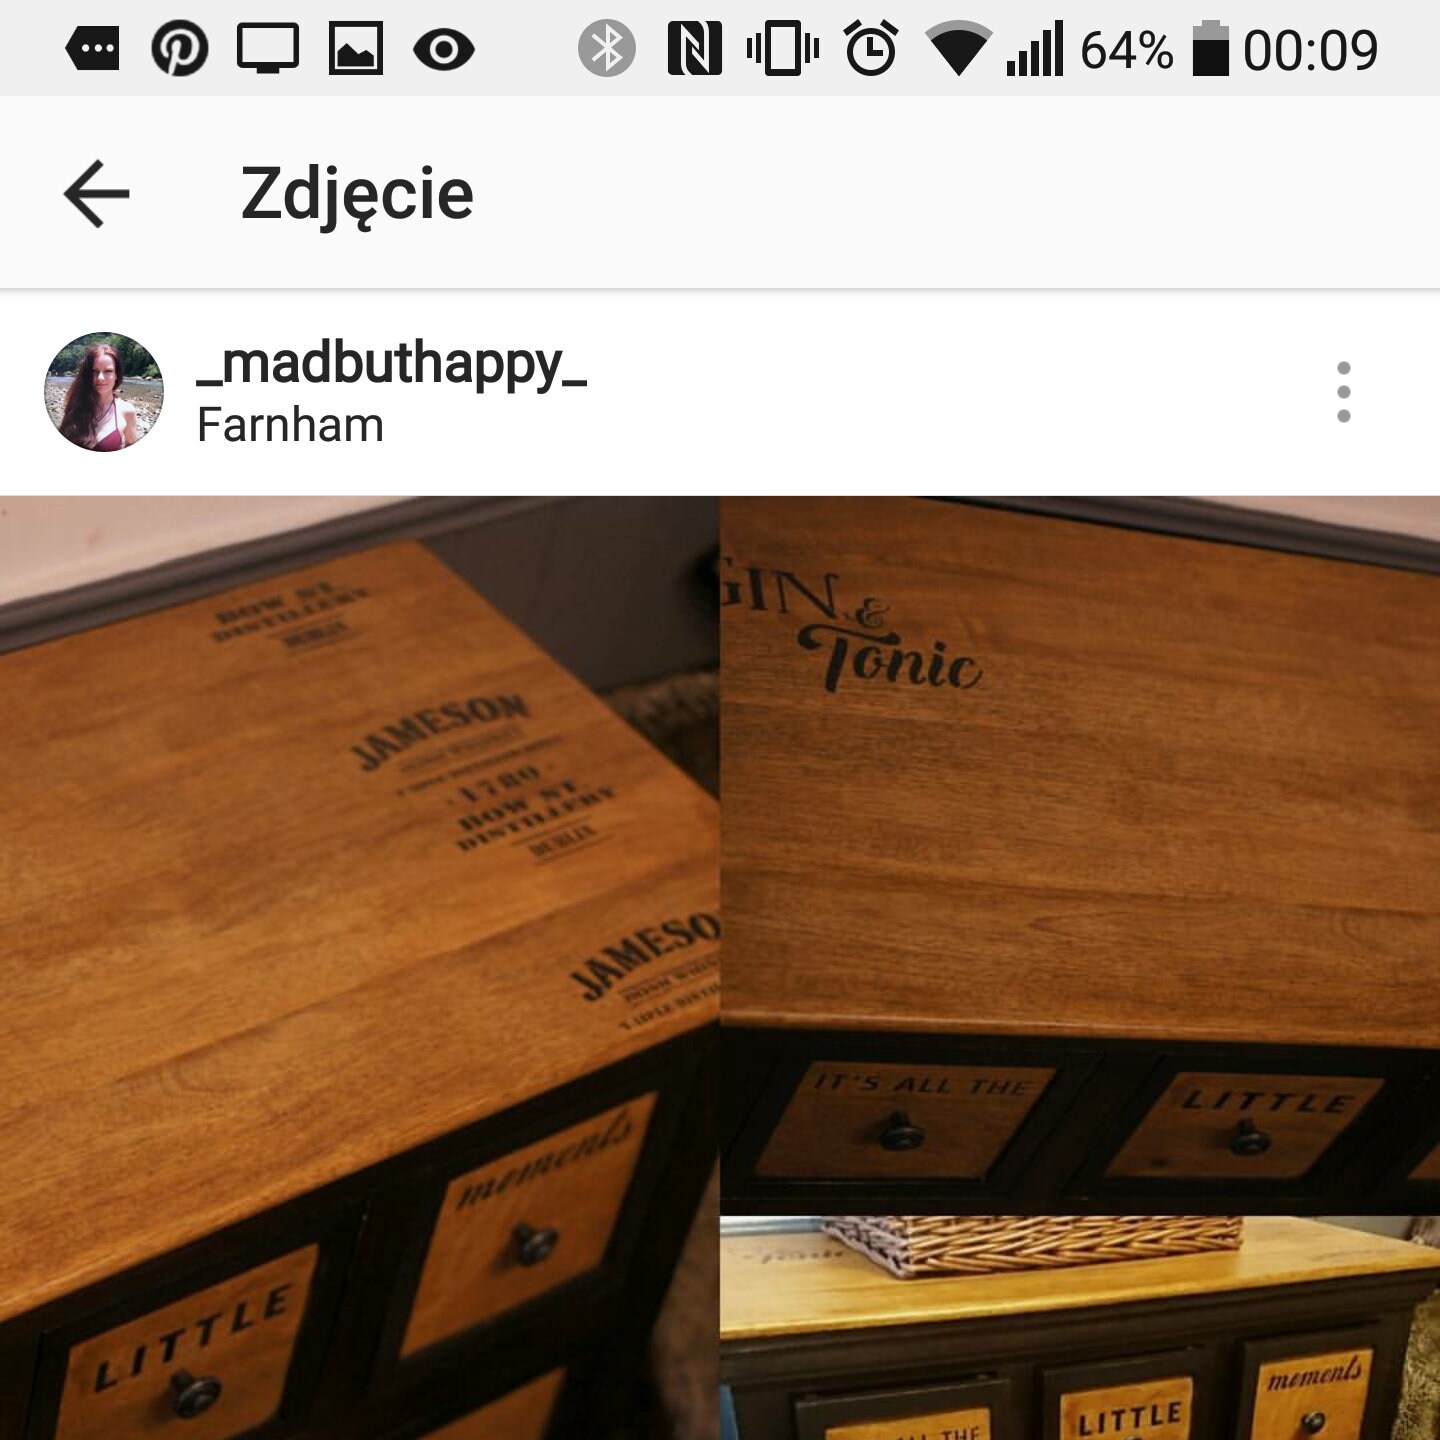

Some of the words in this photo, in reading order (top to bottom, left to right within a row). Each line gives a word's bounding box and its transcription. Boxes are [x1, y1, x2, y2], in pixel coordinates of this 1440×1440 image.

[1081, 29, 1174, 71] 64%
[1244, 28, 1378, 72] 00:09
[242, 163, 474, 235] Zdjęcie
[195, 337, 588, 395] _madbuthappy_
[199, 404, 383, 443] Farnham
[798, 624, 982, 693] Tonic
[352, 694, 529, 771] JAMESON
[894, 1076, 951, 1094] ALL
[970, 1079, 1031, 1096] THE
[1182, 1090, 1355, 1113] LITTLE
[94, 1283, 292, 1393] LITTLE
[1268, 1355, 1362, 1392] moments
[1079, 1401, 1182, 1437] LITTLE
